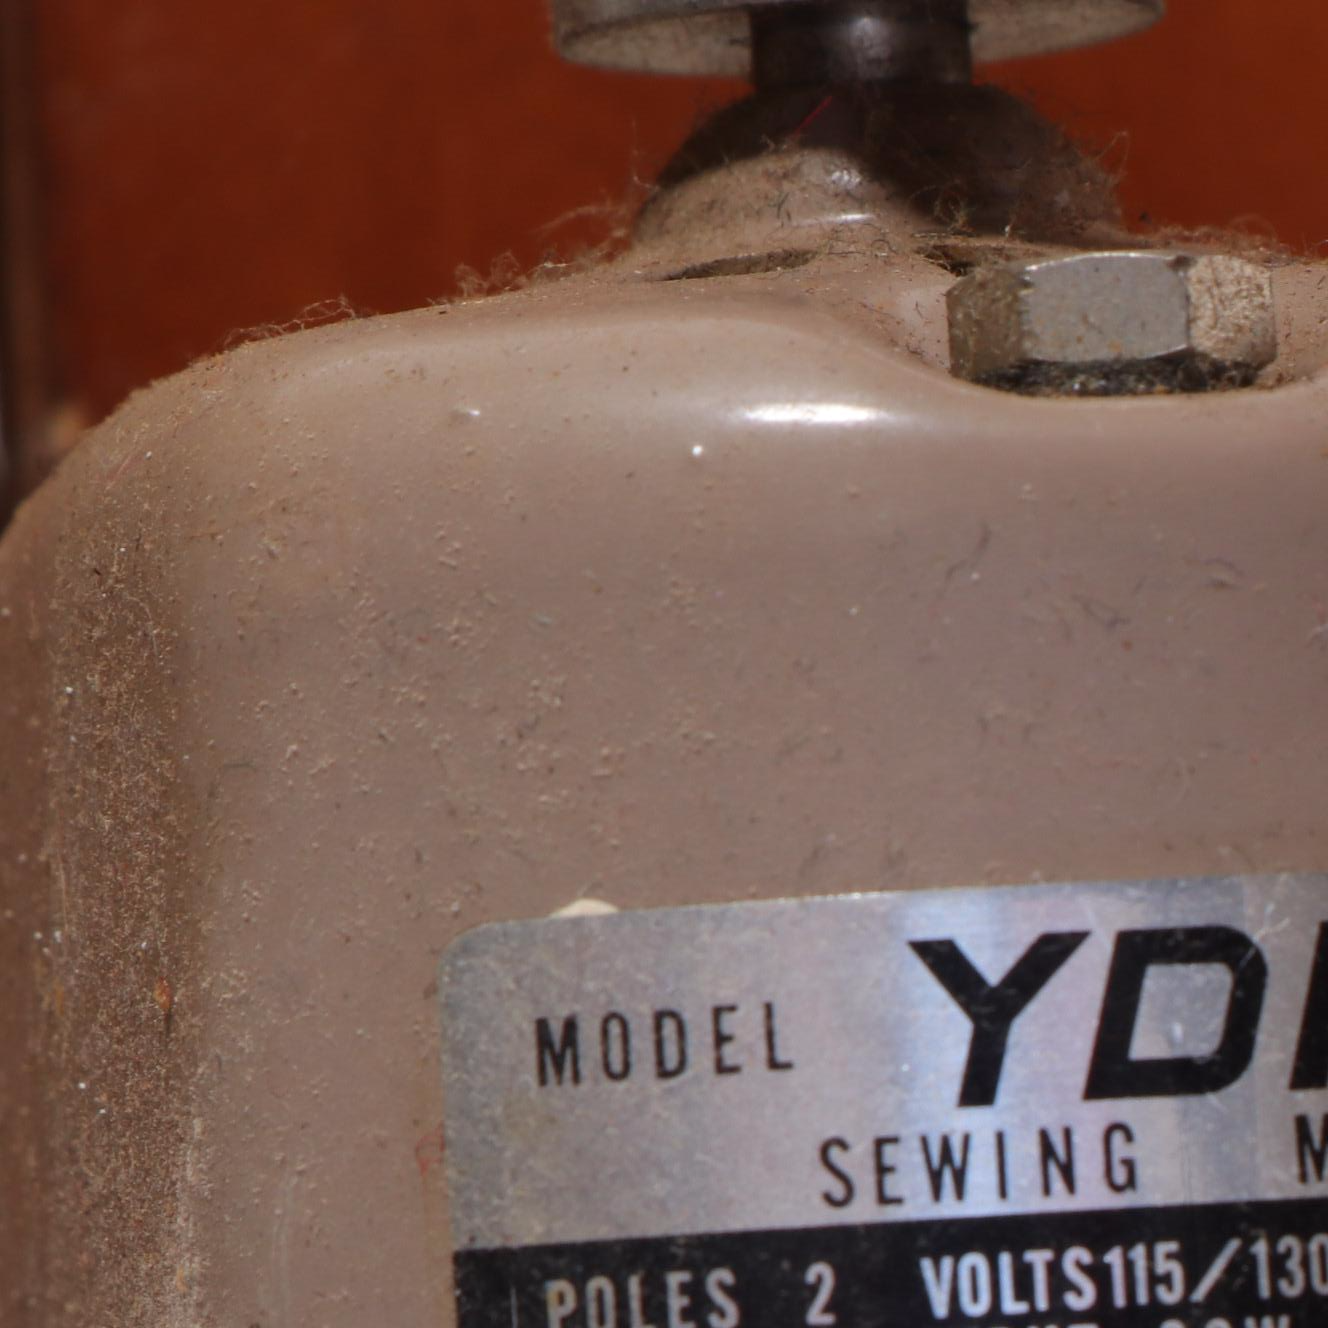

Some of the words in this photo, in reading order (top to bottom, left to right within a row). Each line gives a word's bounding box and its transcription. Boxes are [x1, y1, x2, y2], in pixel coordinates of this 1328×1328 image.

[536, 1002, 794, 1086] MODEL
[819, 1123, 1137, 1208] SEWING
[804, 1260, 836, 1327] 2
